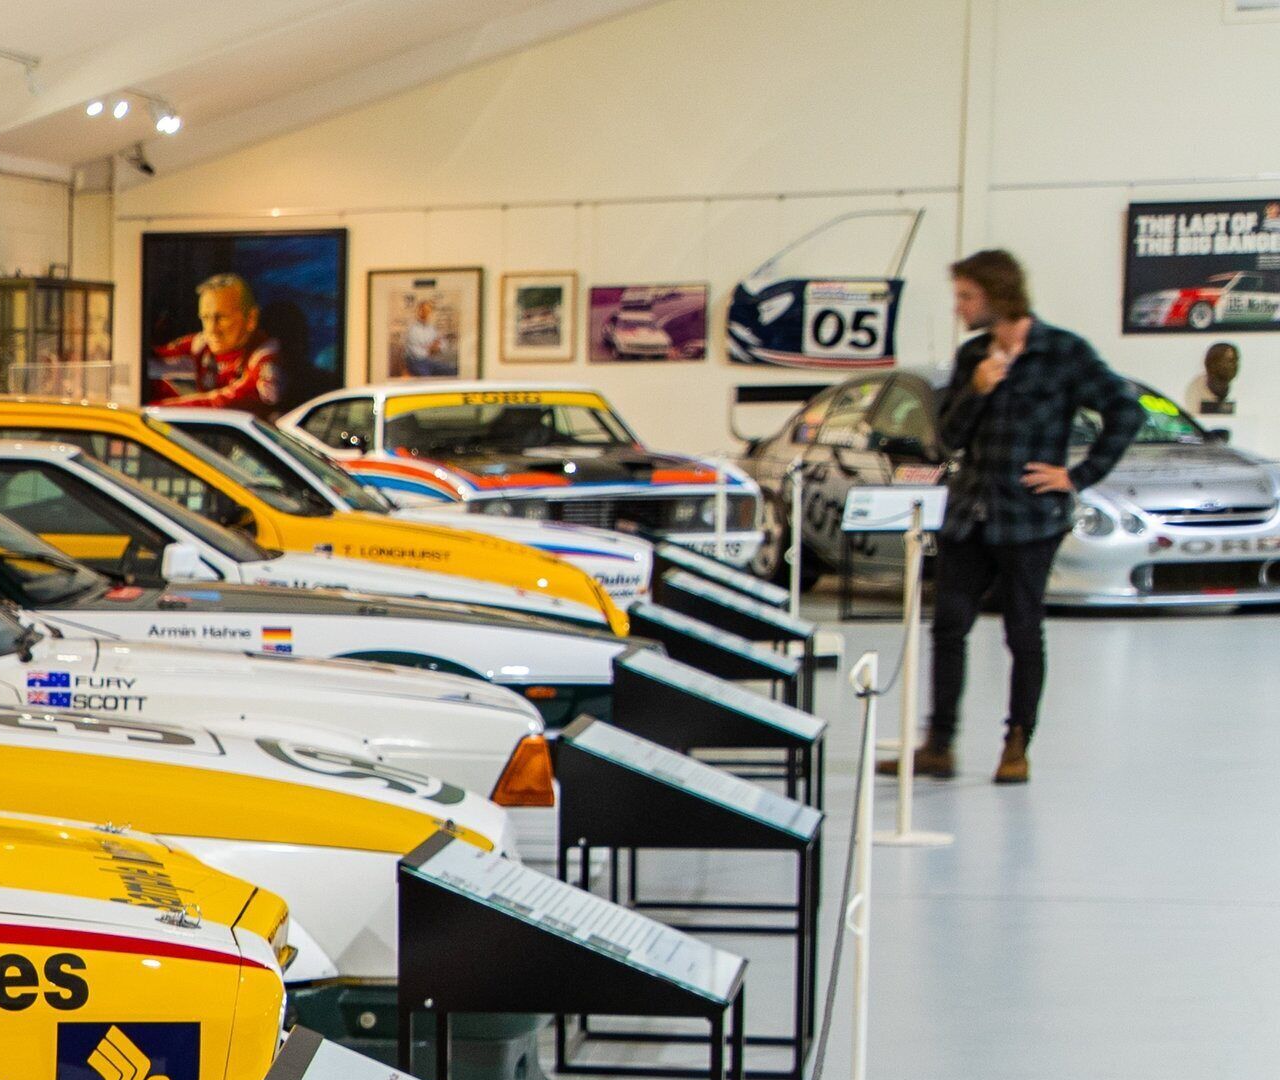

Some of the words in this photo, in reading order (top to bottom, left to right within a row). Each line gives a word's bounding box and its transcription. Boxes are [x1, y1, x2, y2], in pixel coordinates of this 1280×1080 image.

[1136, 214, 1176, 236] THE
[1178, 212, 1230, 236] LAST
[1231, 211, 1257, 235] OF
[1135, 236, 1175, 256] THE
[1177, 235, 1212, 255] BIG
[812, 309, 879, 349] 05
[148, 624, 197, 638] Armin
[202, 625, 252, 639] Hahne
[75, 678, 137, 689] FURY
[72, 695, 148, 711] SCOTT
